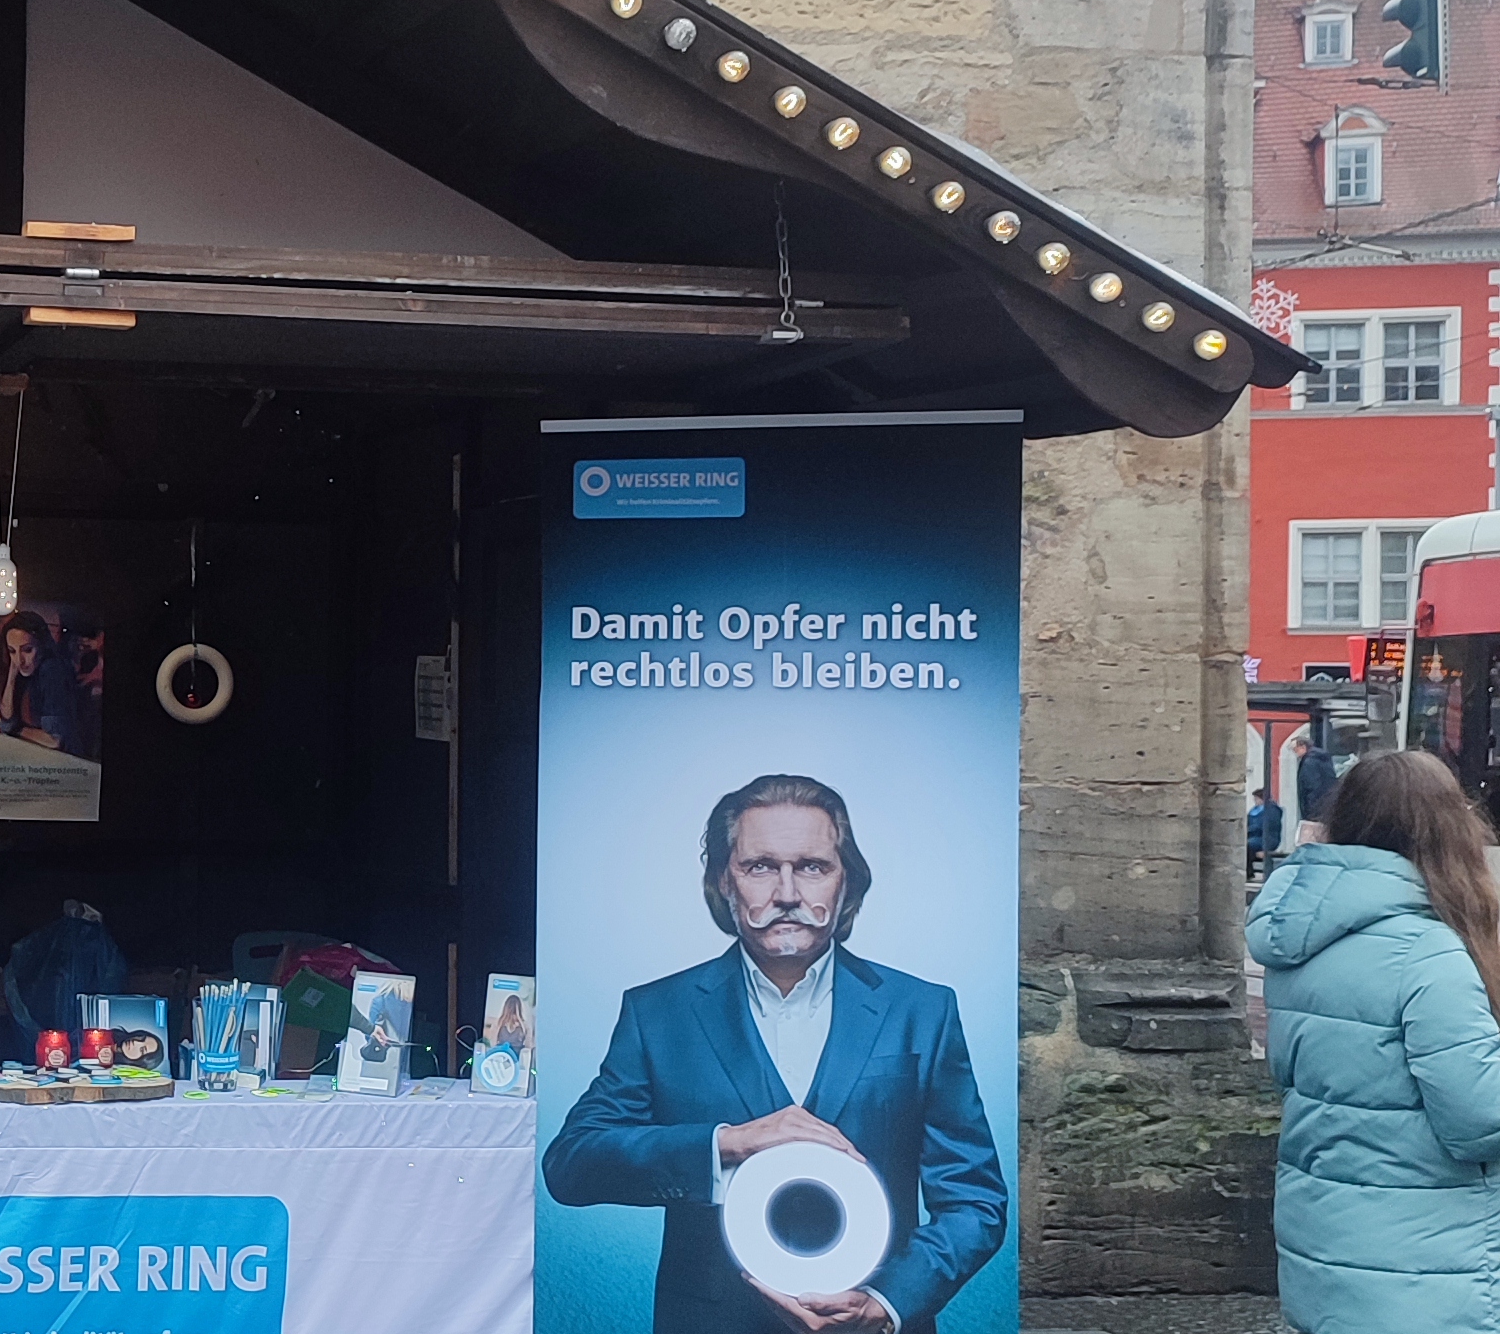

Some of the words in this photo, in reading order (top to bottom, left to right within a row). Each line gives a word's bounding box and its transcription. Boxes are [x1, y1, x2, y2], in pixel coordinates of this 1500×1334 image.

[616, 473, 690, 488] WEISSER
[695, 472, 739, 487] RING
[571, 604, 704, 640] Damit
[719, 603, 845, 650] Opfer
[862, 603, 978, 640] nicht
[570, 652, 753, 688] rechtlos
[772, 652, 961, 689] bleiben.
[137, 1244, 269, 1293] RING
